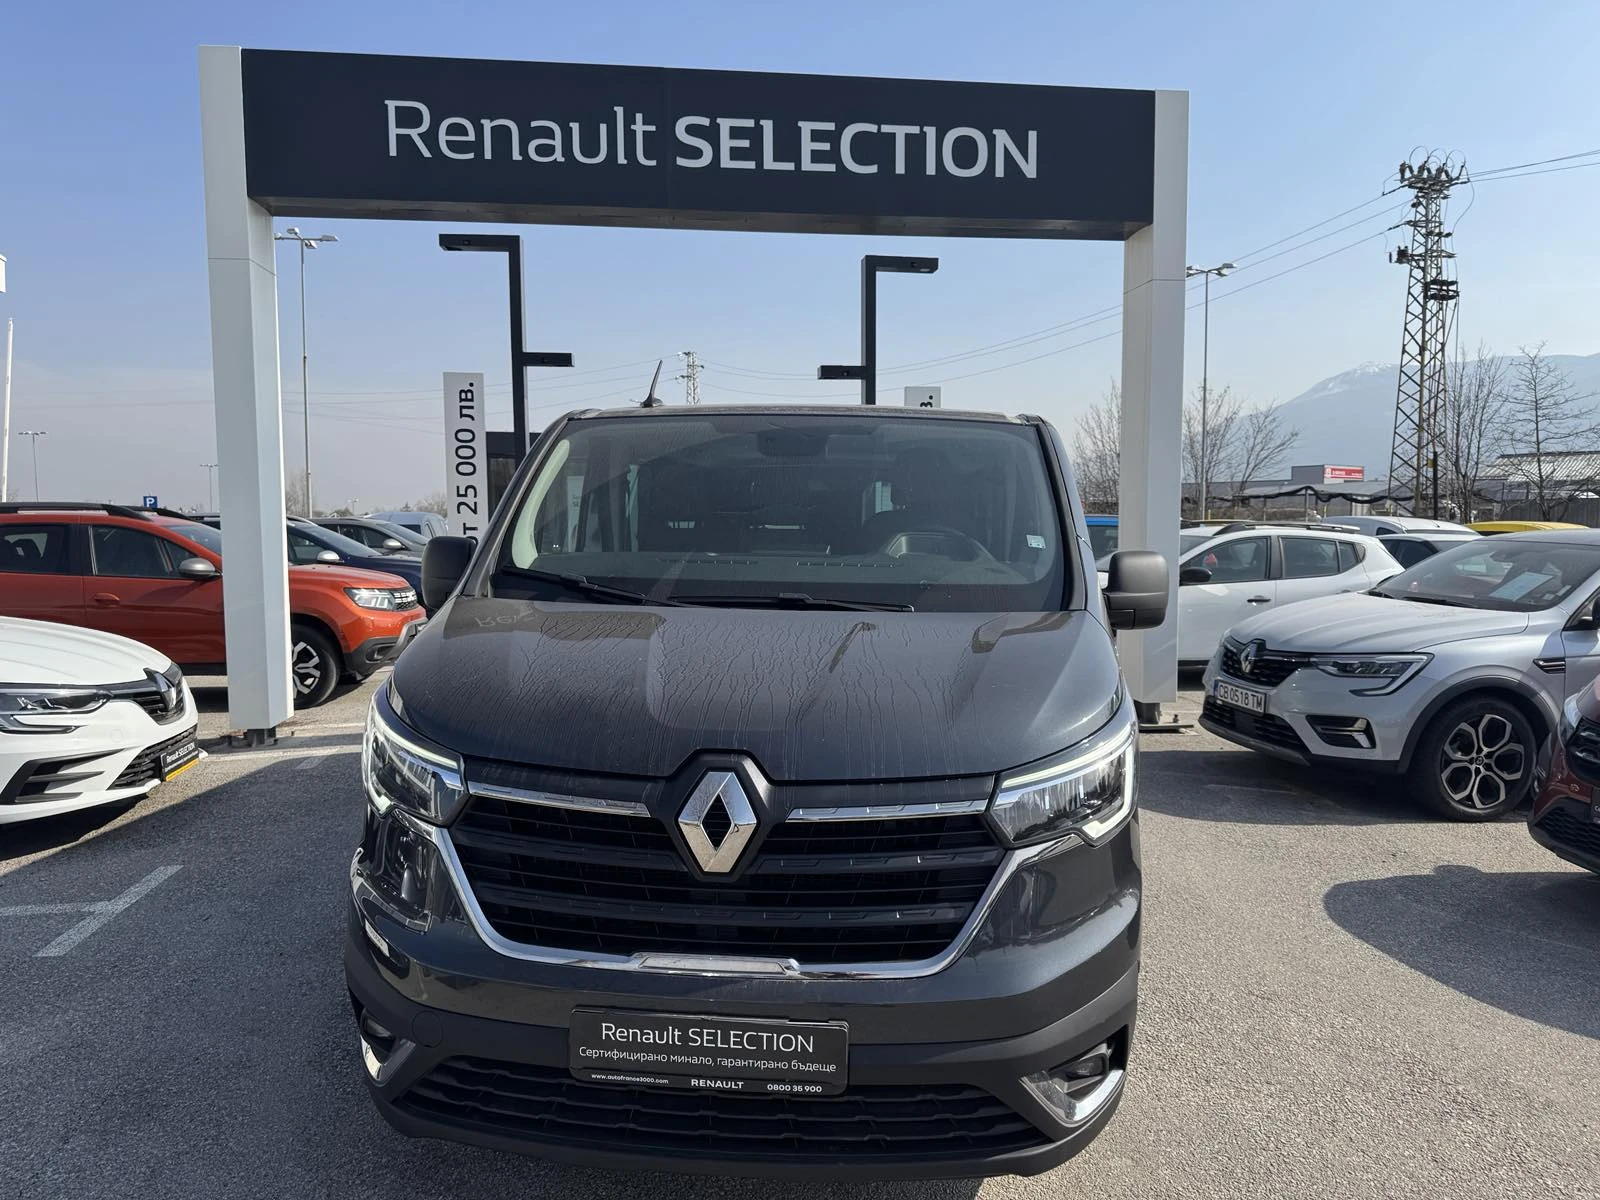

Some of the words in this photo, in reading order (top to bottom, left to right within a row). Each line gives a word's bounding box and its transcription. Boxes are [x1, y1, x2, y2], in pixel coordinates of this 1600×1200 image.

[384, 99, 657, 166] Renault
[675, 115, 1037, 178] SELECTION
[459, 382, 475, 421] лв.
[455, 428, 477, 476] 000
[146, 497, 155, 508] P
[456, 485, 478, 515] 25
[1230, 687, 1250, 706] 0518
[601, 1022, 682, 1045] Renault
[688, 1028, 813, 1053] SELECTION
[579, 1046, 668, 1062] Сертифицирано
[670, 1054, 715, 1067] минало,
[717, 1058, 789, 1070] гарантирано
[791, 1060, 837, 1072] бъдеще
[691, 1078, 744, 1089] RENAULT
[767, 1083, 791, 1092] 0800
[792, 1084, 803, 1092] 35
[804, 1085, 823, 1093] 900
